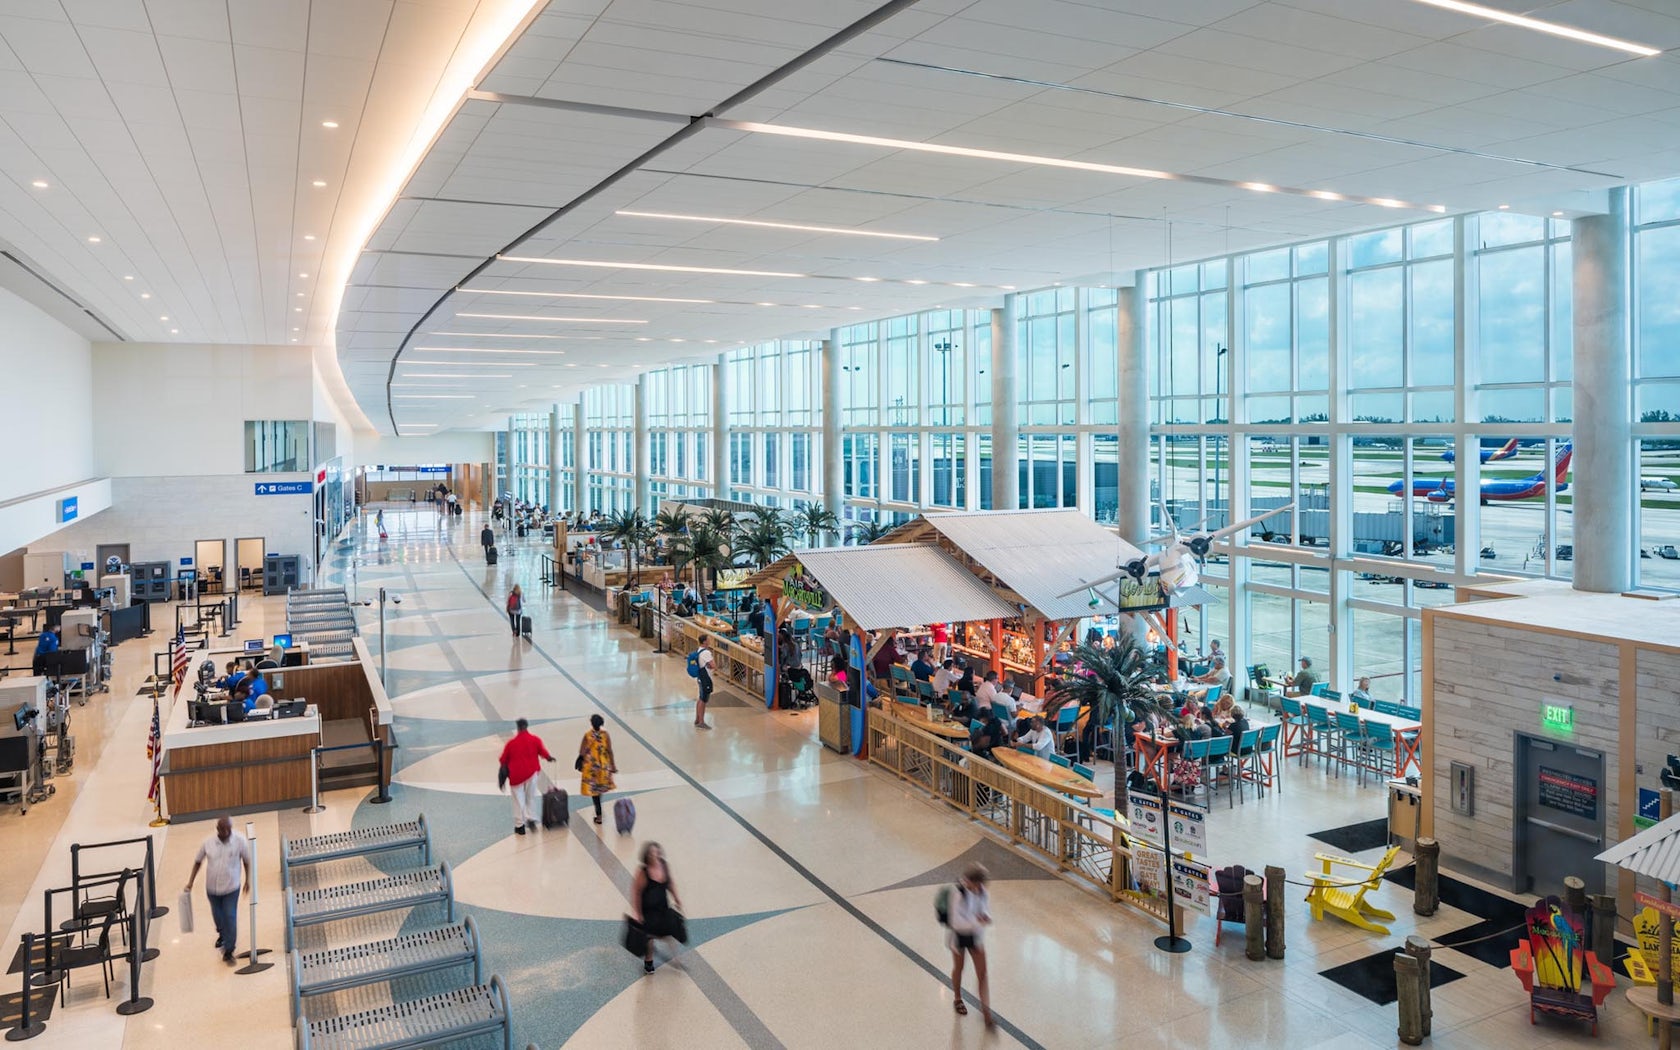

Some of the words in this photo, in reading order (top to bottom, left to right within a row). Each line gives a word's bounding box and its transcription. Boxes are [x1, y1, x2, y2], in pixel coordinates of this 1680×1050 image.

[789, 579, 805, 590] AIR
[1546, 705, 1568, 723] EXIT
[1140, 800, 1156, 808] GATES
[1180, 810, 1199, 820] GATES
[1136, 850, 1158, 860] GREAT
[1136, 858, 1160, 868] TASTES
[1140, 871, 1158, 880] GATE
[1183, 867, 1203, 878] GATES
